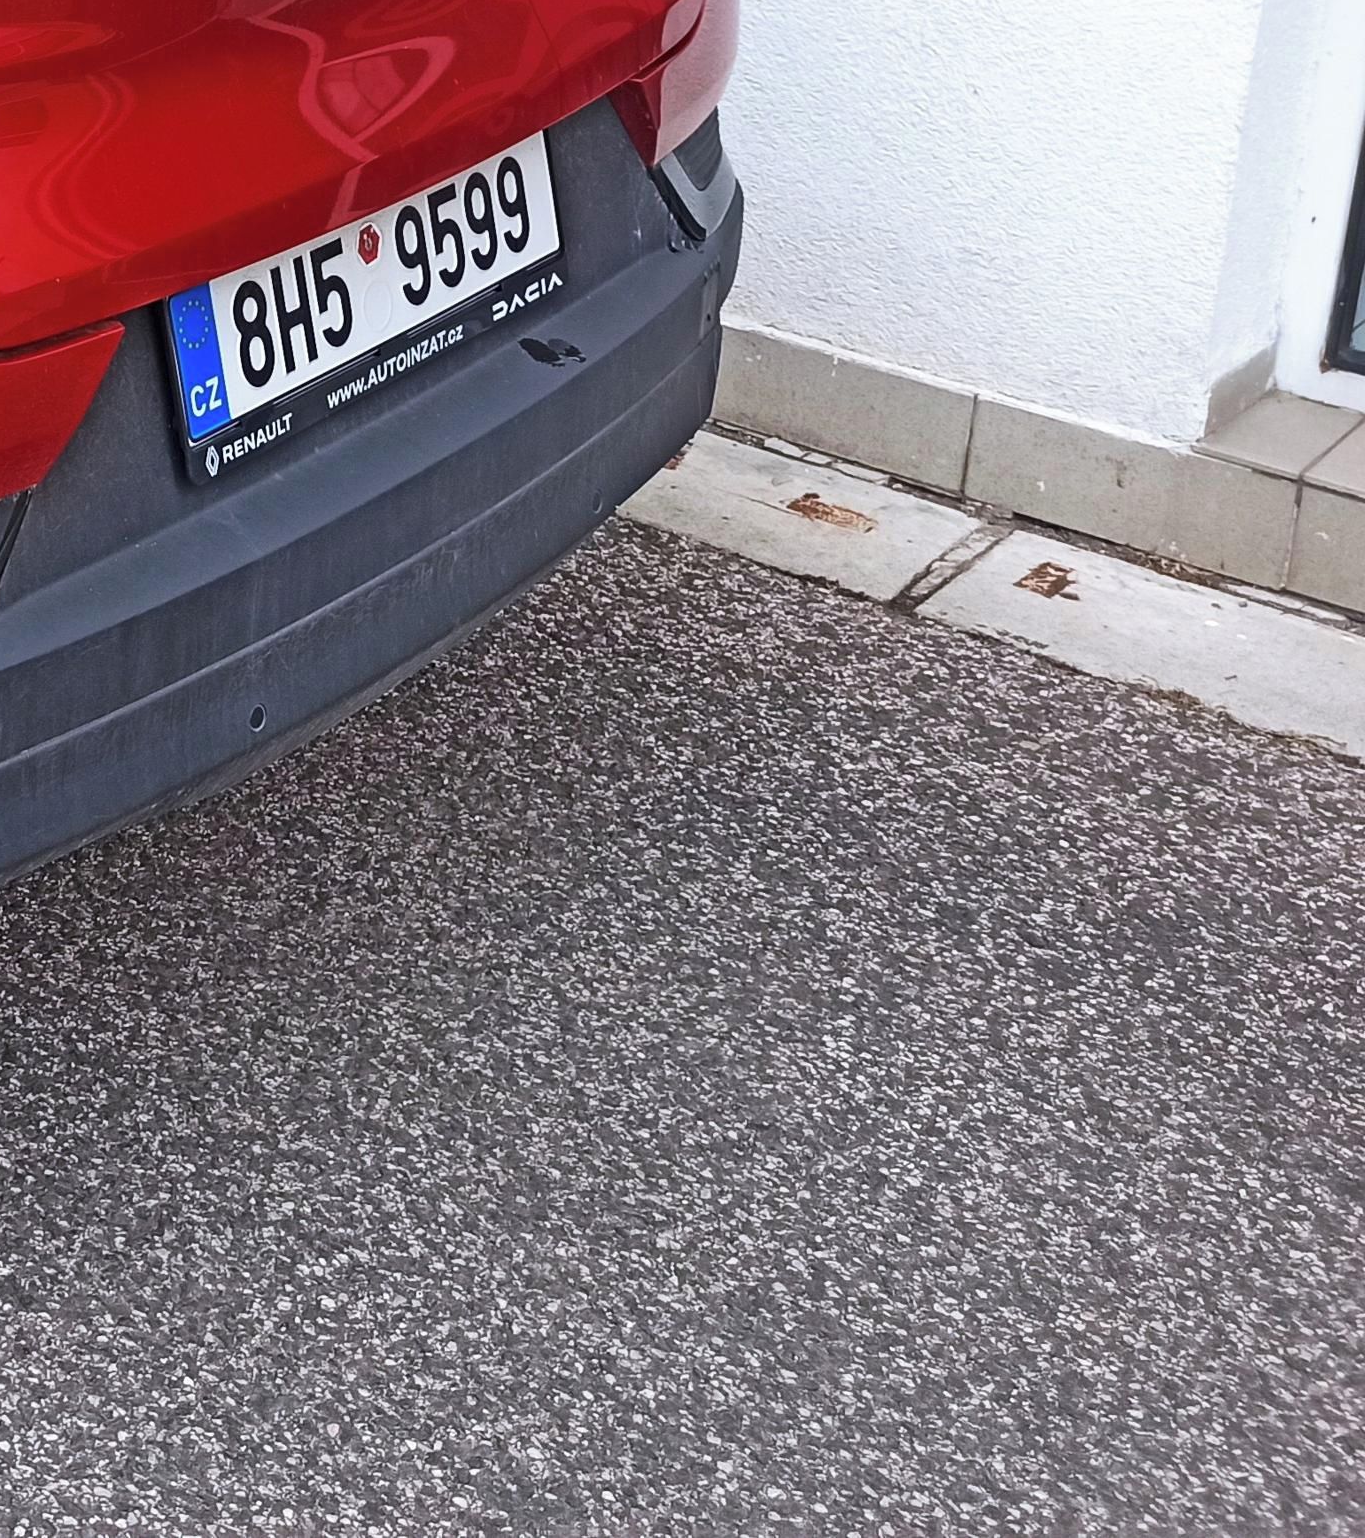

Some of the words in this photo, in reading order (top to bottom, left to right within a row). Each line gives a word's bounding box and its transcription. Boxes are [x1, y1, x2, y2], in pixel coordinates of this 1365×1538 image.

[232, 237, 353, 388] 8H5
[394, 156, 530, 306] 9599
[491, 271, 563, 322] DACIA
[326, 324, 464, 410] www.AUTOINZAT.cz
[189, 376, 223, 418] CZ
[221, 412, 293, 464] RENAULT
